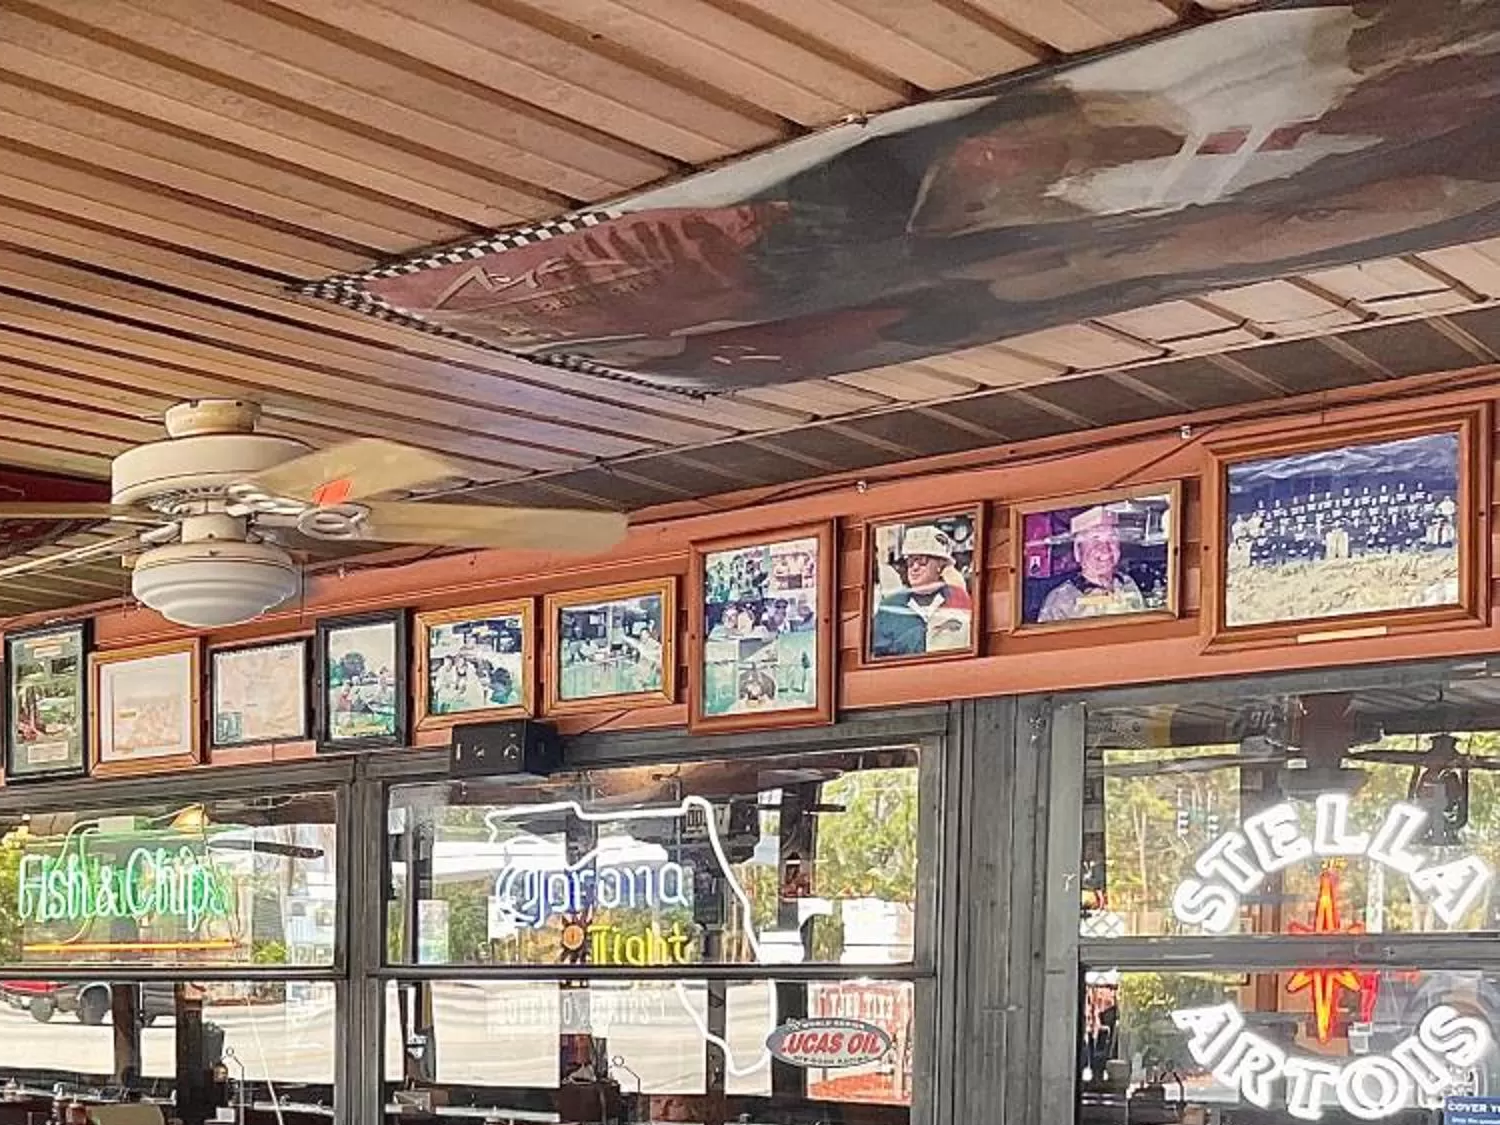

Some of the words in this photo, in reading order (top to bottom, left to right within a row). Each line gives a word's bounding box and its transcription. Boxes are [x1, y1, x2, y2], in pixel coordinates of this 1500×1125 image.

[127, 846, 228, 932] Chips
[496, 862, 690, 928] Corona
[1172, 793, 1491, 935] STELLA
[847, 1032, 882, 1055] OIL
[1171, 1003, 1493, 1120] ARTOIS
[1447, 1103, 1487, 1113] COVER
